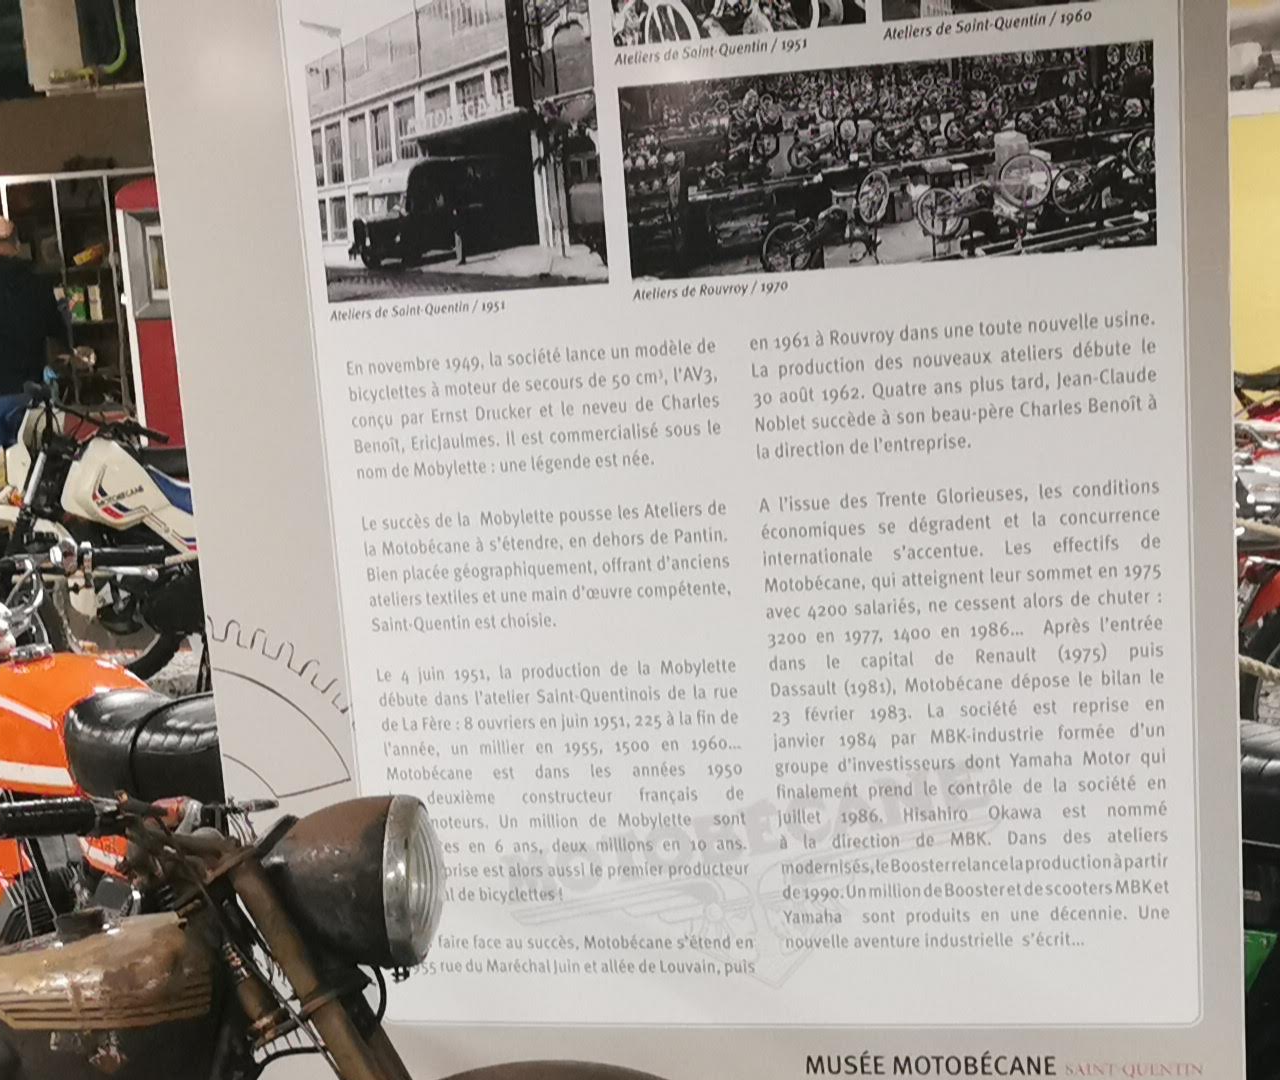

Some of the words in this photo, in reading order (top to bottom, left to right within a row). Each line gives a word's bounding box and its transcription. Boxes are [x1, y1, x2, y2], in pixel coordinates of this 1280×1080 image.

[882, 25, 932, 42] Ateliers
[935, 21, 952, 36] de
[955, 12, 1046, 34] Saint-Quentin
[1060, 8, 1093, 26] 1960
[613, 46, 660, 66] Ateliers
[663, 46, 679, 63] de
[682, 40, 768, 59] Saint-Quentin
[780, 37, 808, 53] 1951
[632, 287, 678, 301] Ateliers
[681, 285, 696, 298] de
[699, 283, 749, 297] Rouvroy
[750, 280, 758, 295] /
[760, 280, 789, 295] 1970
[329, 308, 372, 322] Ateliers
[374, 306, 389, 319] de
[391, 300, 469, 318] Saint-Quentin
[471, 299, 479, 314] /
[481, 300, 505, 314] 1951
[346, 360, 364, 376] En
[368, 356, 440, 375] novembre
[445, 355, 484, 373] 1949,
[489, 350, 503, 367] la
[506, 346, 561, 366] société
[565, 346, 606, 363] lance
[610, 346, 630, 360] un
[634, 338, 692, 358] modèle
[696, 336, 716, 355] de
[751, 362, 769, 378] La
[778, 356, 865, 380] production
[874, 354, 903, 371] des
[912, 351, 992, 368] nouveaux
[1000, 344, 1063, 363] ateliers
[1072, 340, 1131, 359] débute
[1141, 336, 1156, 354] le
[754, 414, 806, 433] Noblet
[811, 410, 876, 430] succède
[881, 408, 891, 426] à
[896, 410, 925, 425] son
[930, 402, 1014, 424] beau-père
[1019, 398, 1082, 418] Charles
[1088, 394, 1142, 414] Benoît
[1147, 393, 1157, 411] à
[361, 515, 377, 532] Le
[381, 512, 430, 531] succès
[434, 512, 453, 528] de
[457, 511, 470, 527] la
[479, 508, 554, 529] Mobylette
[559, 508, 612, 527] pousse
[617, 504, 639, 521] les
[643, 501, 703, 519] Ateliers
[707, 498, 726, 516] de
[762, 546, 873, 567] internationale
[1004, 539, 1032, 556] Les
[1052, 534, 1119, 554] effectifs
[1140, 532, 1161, 550] de
[375, 668, 392, 682] Le
[400, 670, 409, 685] 4
[417, 666, 445, 685] juin
[453, 668, 490, 684] 1951,
[498, 664, 512, 680] la
[521, 661, 601, 683] production
[609, 660, 628, 677] de
[637, 659, 651, 676] la
[660, 658, 736, 678] Mobylette
[768, 654, 806, 672] dans
[826, 653, 840, 670] le
[860, 650, 914, 672] capital
[934, 649, 954, 666] de
[975, 646, 1036, 664] Renault
[1057, 641, 1107, 664] (1975)
[1129, 641, 1164, 662] puis
[386, 764, 473, 781] Motobécane
[492, 766, 515, 780] est
[534, 763, 570, 780] dans
[589, 762, 612, 778] les
[632, 760, 686, 778] années
[707, 763, 743, 780] 1950
[782, 906, 842, 926] Yamaha
[862, 909, 895, 924] sont
[905, 906, 971, 927] produits
[980, 910, 999, 922] en
[1010, 909, 1039, 922] une
[1049, 904, 1127, 922] décennie.
[1138, 904, 1170, 920] Une
[805, 1050, 885, 1075] MUSÉE
[892, 1050, 1057, 1076] MOTOBÉCANE
